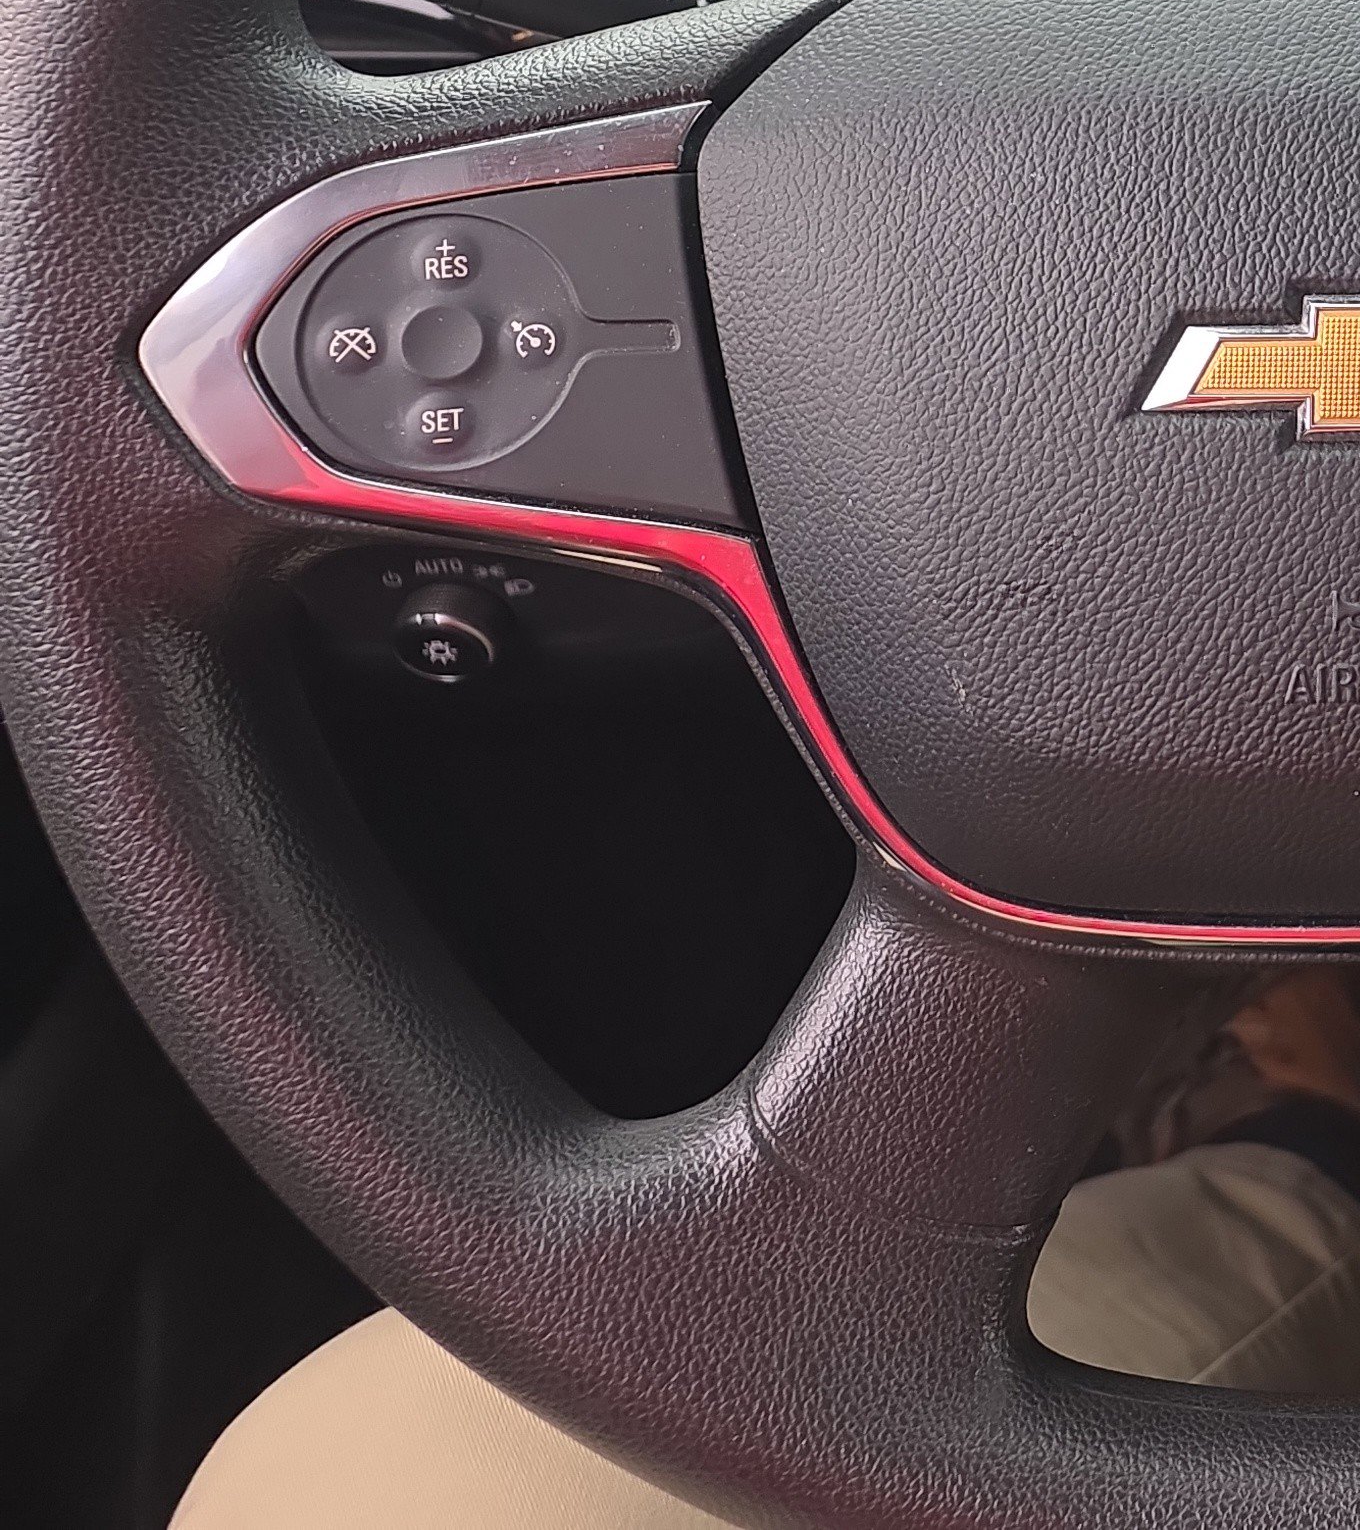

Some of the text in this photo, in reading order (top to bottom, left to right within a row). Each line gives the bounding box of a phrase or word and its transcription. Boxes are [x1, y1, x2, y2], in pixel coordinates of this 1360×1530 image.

[425, 255, 468, 279] RES
[421, 407, 464, 432] SET
[415, 557, 463, 575] AUTO
